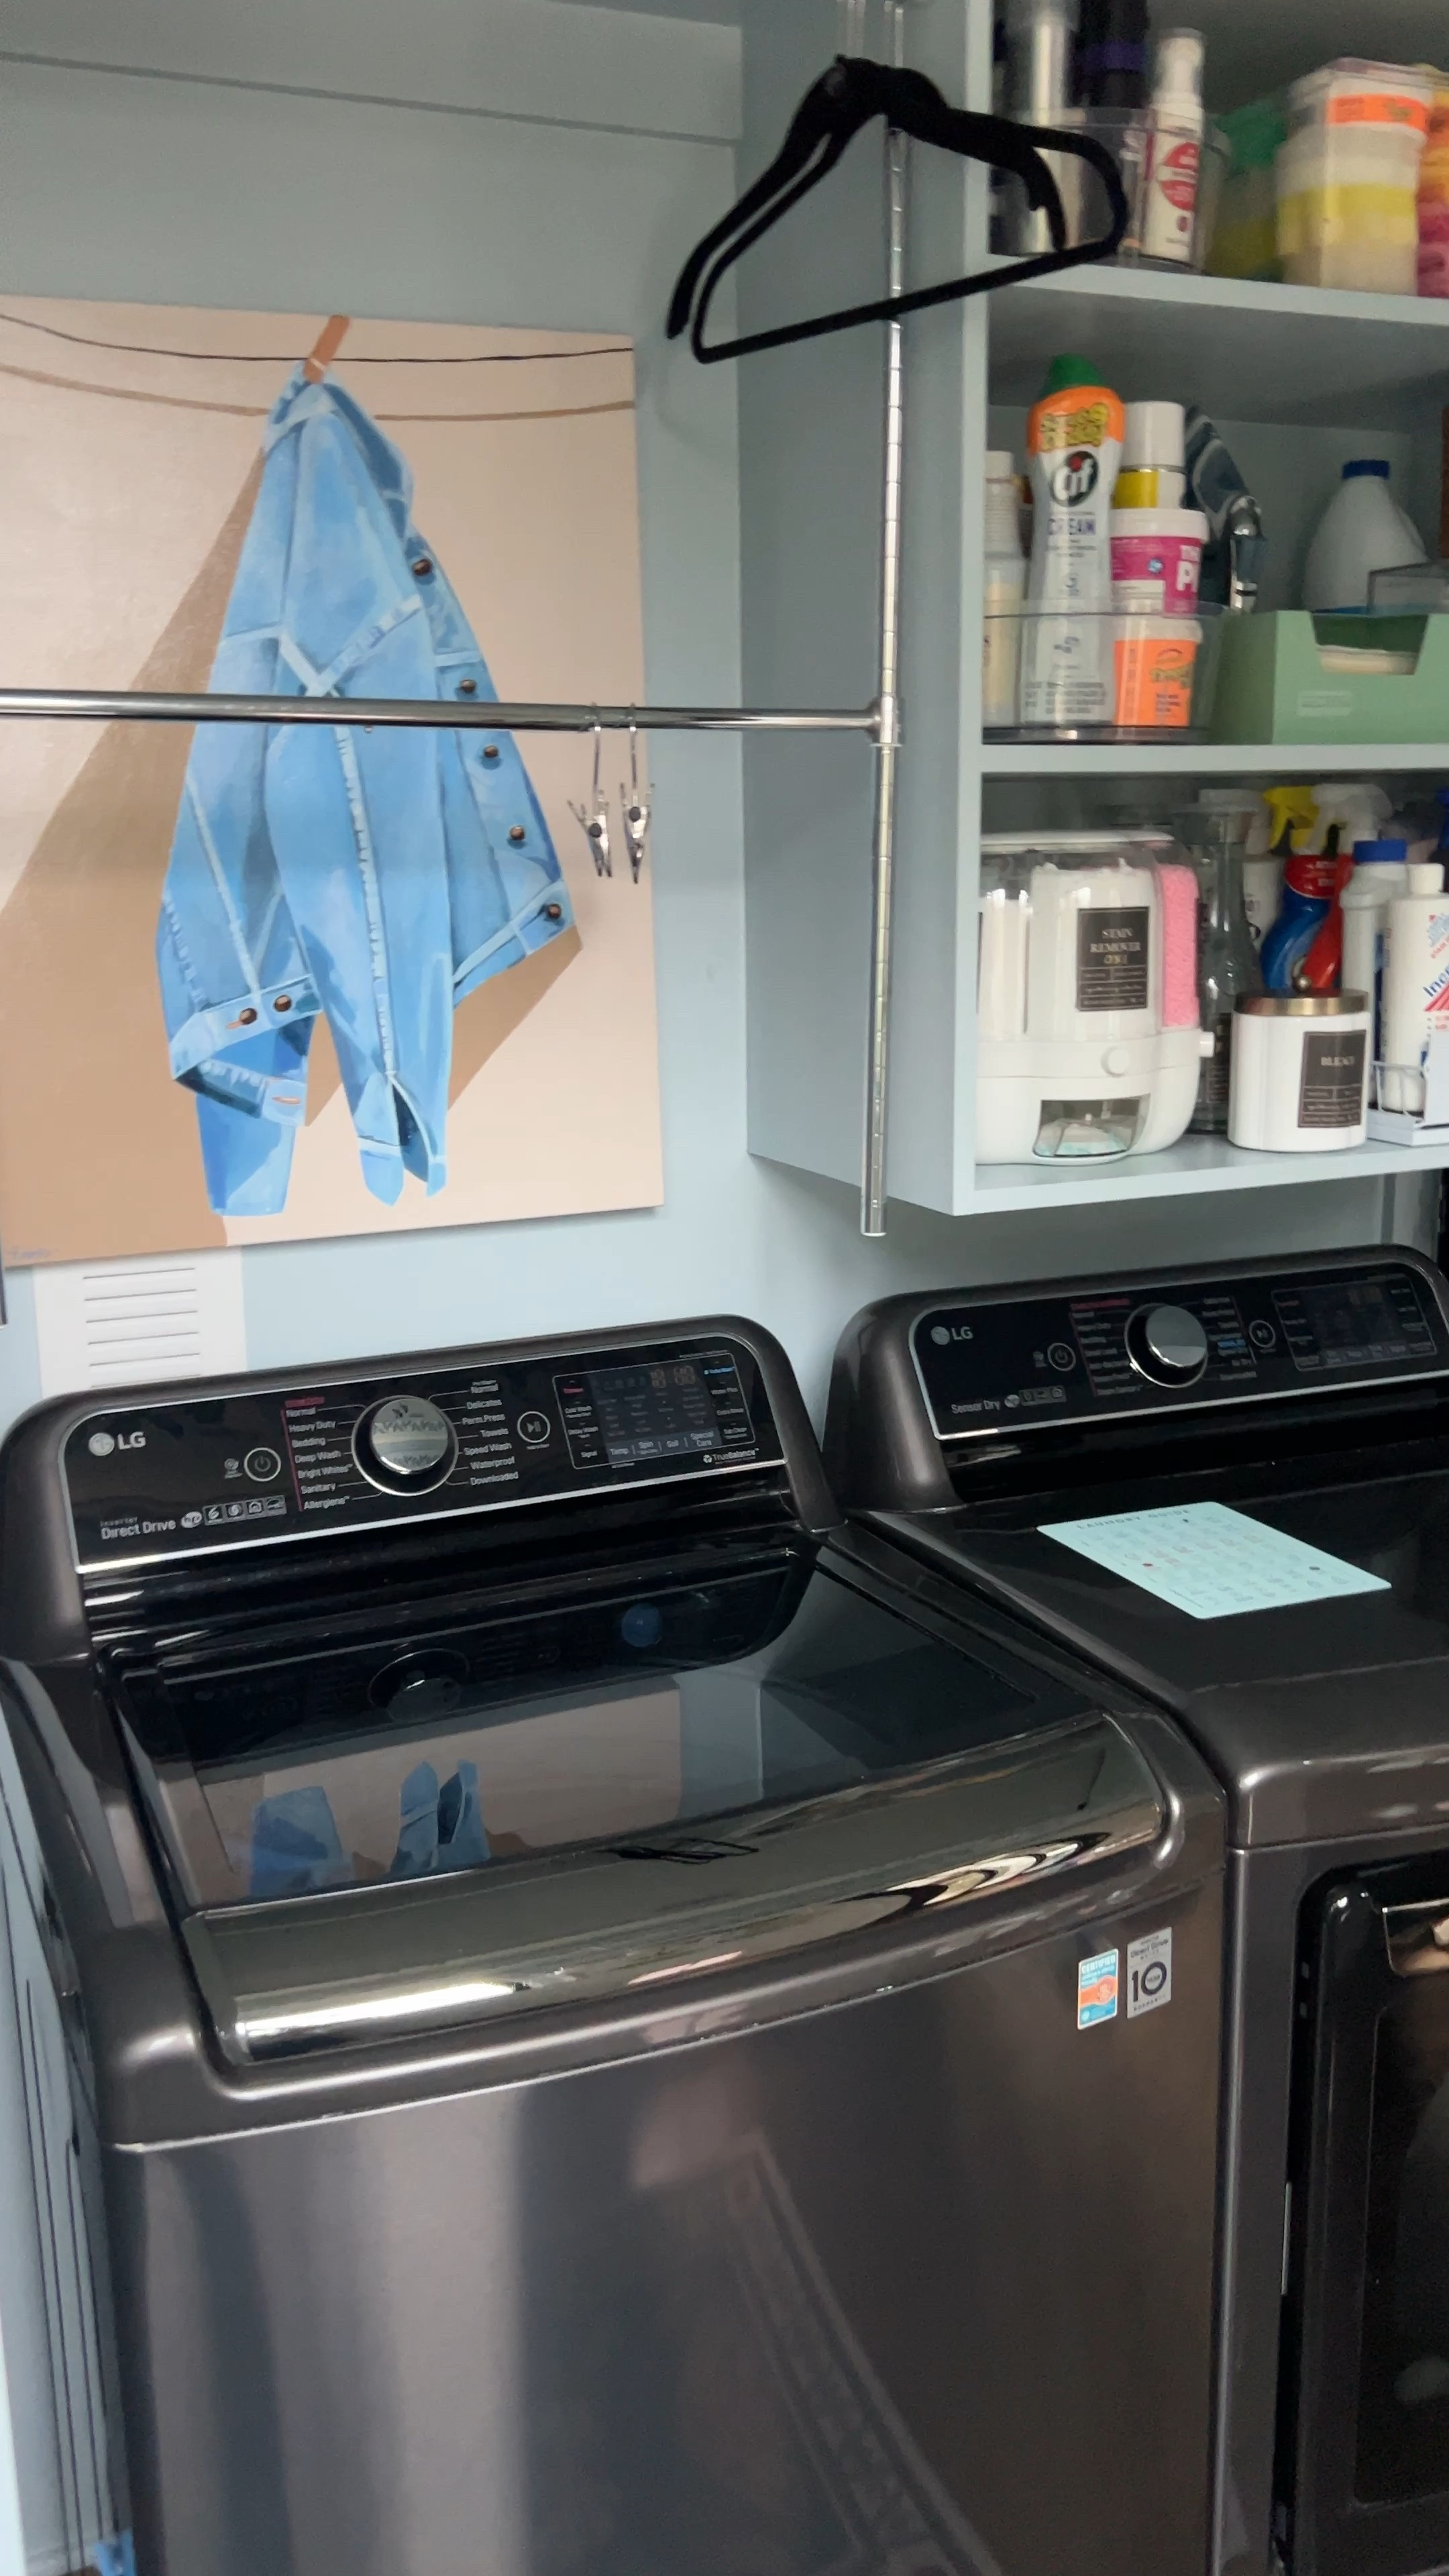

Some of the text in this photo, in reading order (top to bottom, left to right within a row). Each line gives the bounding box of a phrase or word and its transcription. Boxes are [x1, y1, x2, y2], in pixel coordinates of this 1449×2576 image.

[1052, 458, 1095, 501] cif
[951, 1326, 974, 1340] LG
[466, 1399, 502, 1410] Delicates
[983, 1399, 1001, 1411] Dry
[288, 1420, 336, 1434] Heavy Duty
[117, 1431, 147, 1450] LG
[294, 1450, 341, 1464] Deep Wash
[470, 1455, 515, 1470] Waterproof
[470, 1470, 519, 1487] Downloaded
[1076, 1509, 1190, 1529] LAUNDRY GUIDE
[101, 1523, 141, 1540] Direct
[142, 1519, 177, 1535] Drive
[1131, 1960, 1167, 2003] 10
